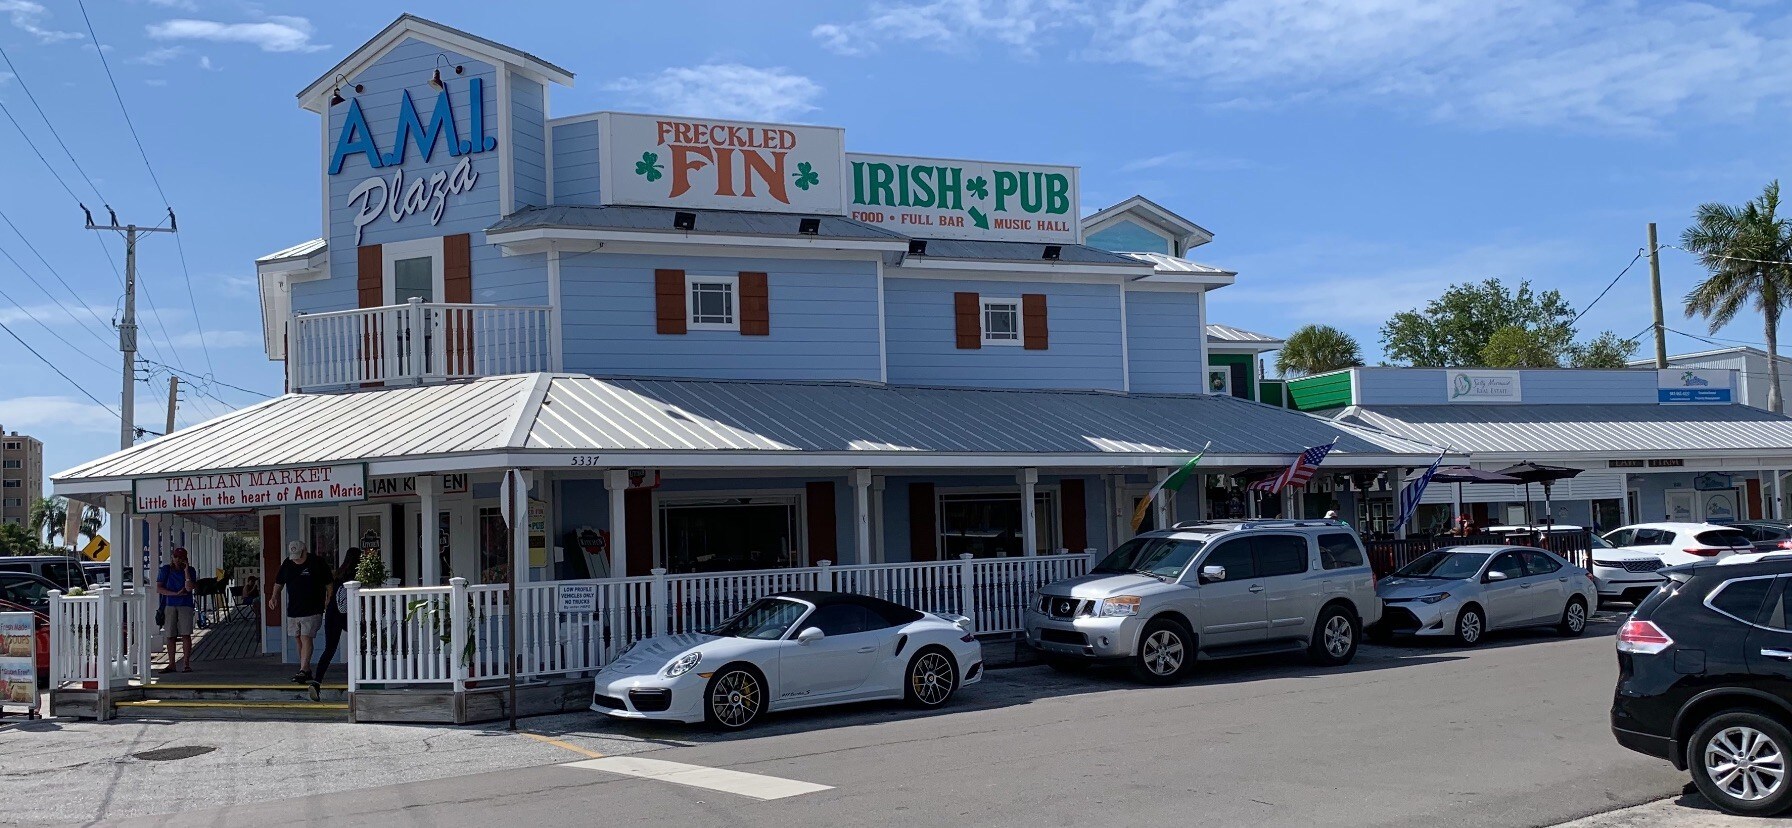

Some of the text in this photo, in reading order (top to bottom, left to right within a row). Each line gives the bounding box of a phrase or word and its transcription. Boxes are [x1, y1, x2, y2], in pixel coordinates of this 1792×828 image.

[328, 77, 498, 175] A.M.I.
[656, 121, 796, 150] FRECKLED
[667, 144, 790, 204] FIN
[851, 160, 1069, 214] IRISH PUB
[347, 156, 479, 246] Plaza
[852, 211, 1069, 232] FOOD FULL BAR MUSIC HALL
[570, 455, 600, 466] 5337
[166, 467, 331, 492] ITALIAN MARKET
[139, 483, 362, 510] Little Italy in the heart of Anna Maria
[532, 521, 545, 529] PUB
